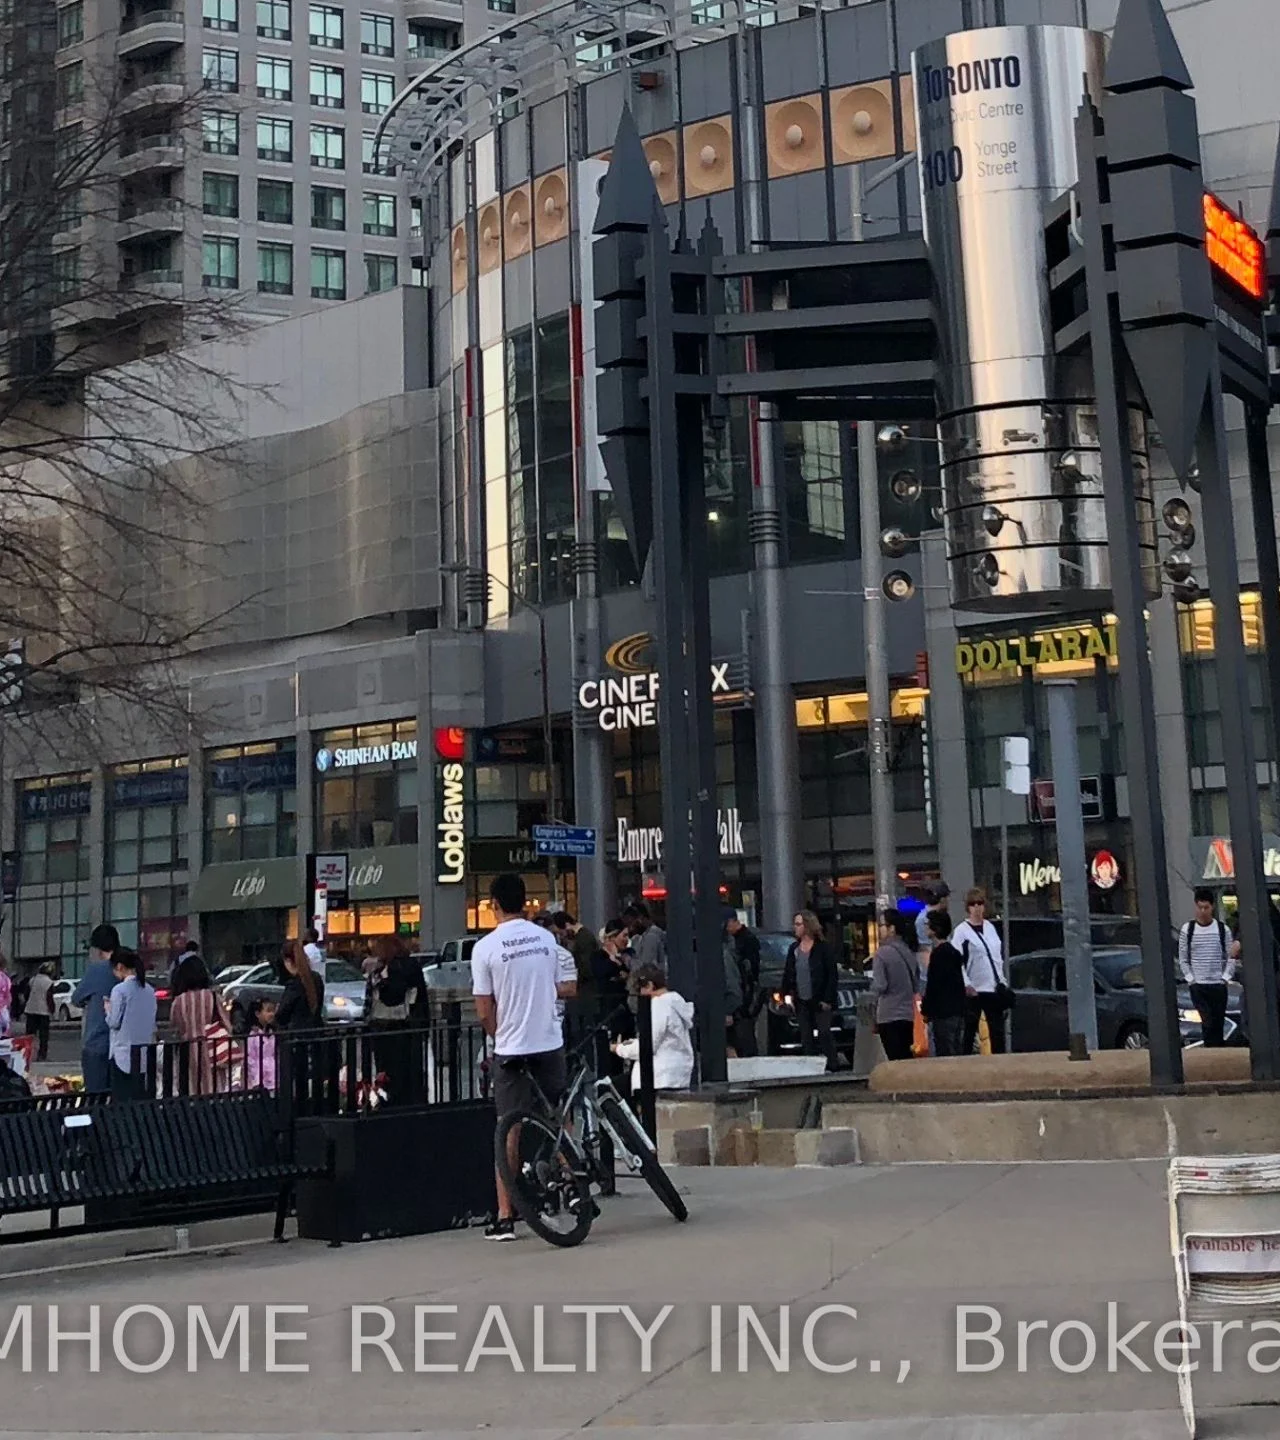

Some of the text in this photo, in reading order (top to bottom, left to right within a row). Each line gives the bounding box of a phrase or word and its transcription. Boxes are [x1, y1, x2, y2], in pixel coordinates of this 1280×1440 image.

[923, 55, 1021, 104] TORONTO
[978, 102, 1024, 119] Centre
[975, 140, 1017, 158] Yonge
[976, 161, 1019, 178] Street
[955, 624, 1119, 673] DOLLARA
[598, 702, 656, 731] CINE
[334, 740, 418, 767] SHINHAN BAN
[437, 762, 464, 883] Loblaws
[617, 816, 664, 874] Empre
[232, 875, 266, 898] LCBO
[348, 863, 384, 887] LCBO
[501, 935, 541, 949] Natation
[501, 947, 550, 963] Swimming
[1186, 1237, 1256, 1252] available
